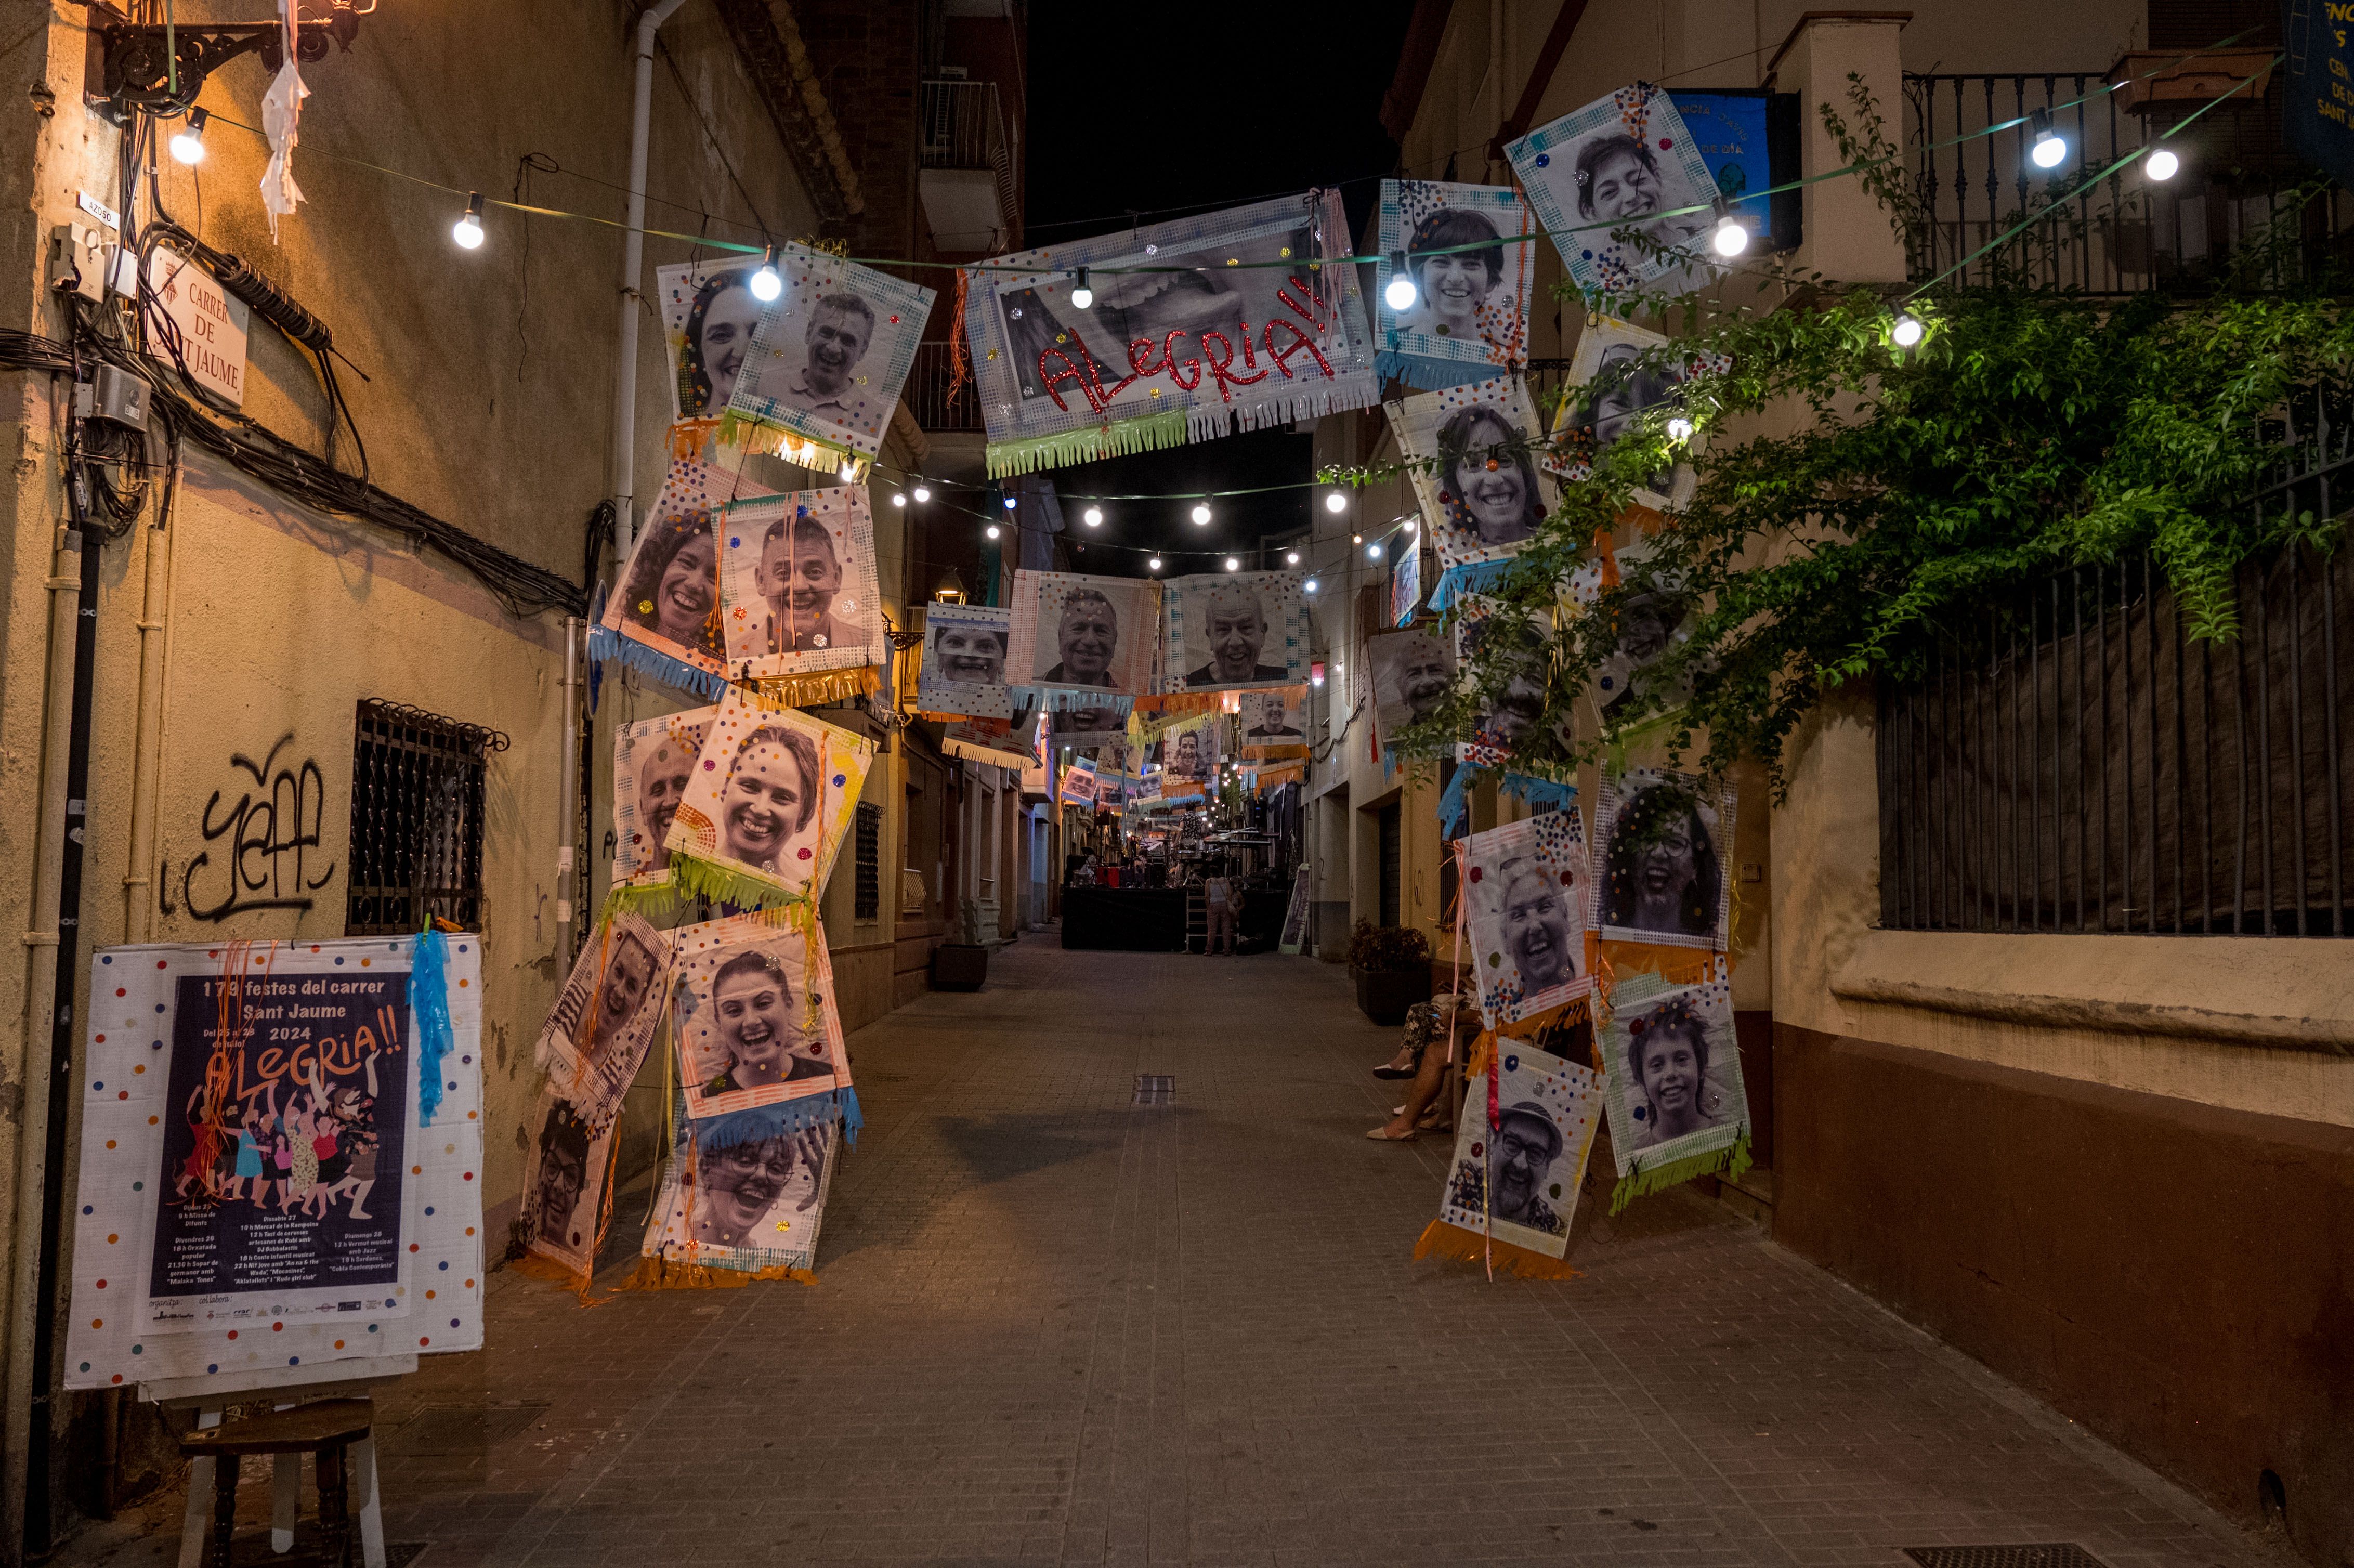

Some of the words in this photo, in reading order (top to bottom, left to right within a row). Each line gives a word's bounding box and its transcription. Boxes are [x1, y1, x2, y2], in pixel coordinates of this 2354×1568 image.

[189, 282, 228, 325] CARRER
[194, 313, 215, 344] DE
[194, 344, 238, 389] JAUME
[245, 981, 296, 997] festes
[300, 979, 326, 995] del
[330, 981, 386, 995] carrer
[243, 1005, 284, 1020] Sant
[289, 1003, 347, 1018] Jaume
[269, 1026, 312, 1041] 2024
